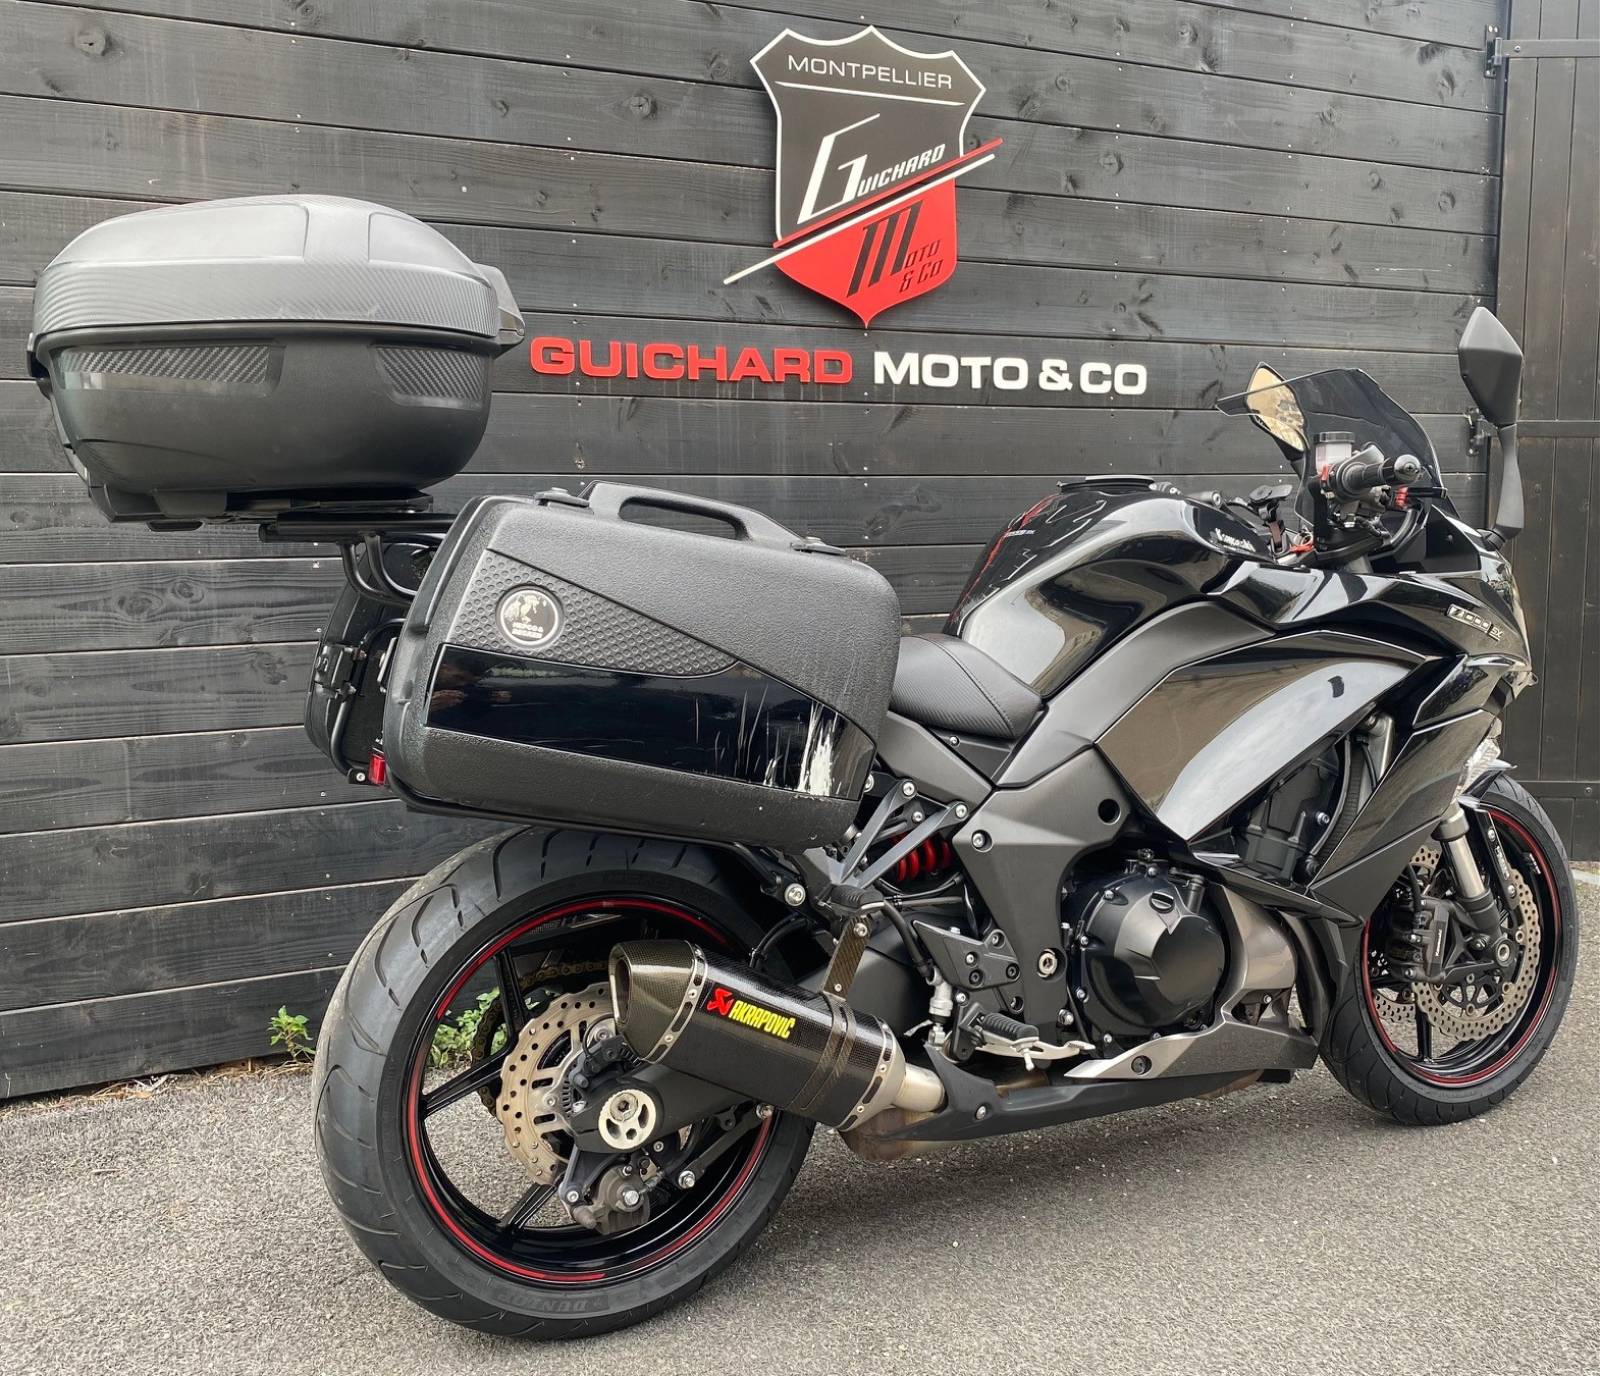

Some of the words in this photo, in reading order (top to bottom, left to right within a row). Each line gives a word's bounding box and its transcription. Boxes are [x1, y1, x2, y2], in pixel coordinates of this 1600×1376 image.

[788, 54, 952, 89] MONTPELLIER
[917, 258, 944, 284] CO
[529, 336, 853, 385] GUICHARD
[874, 351, 1029, 391] MOTO
[1079, 362, 1147, 396] CO
